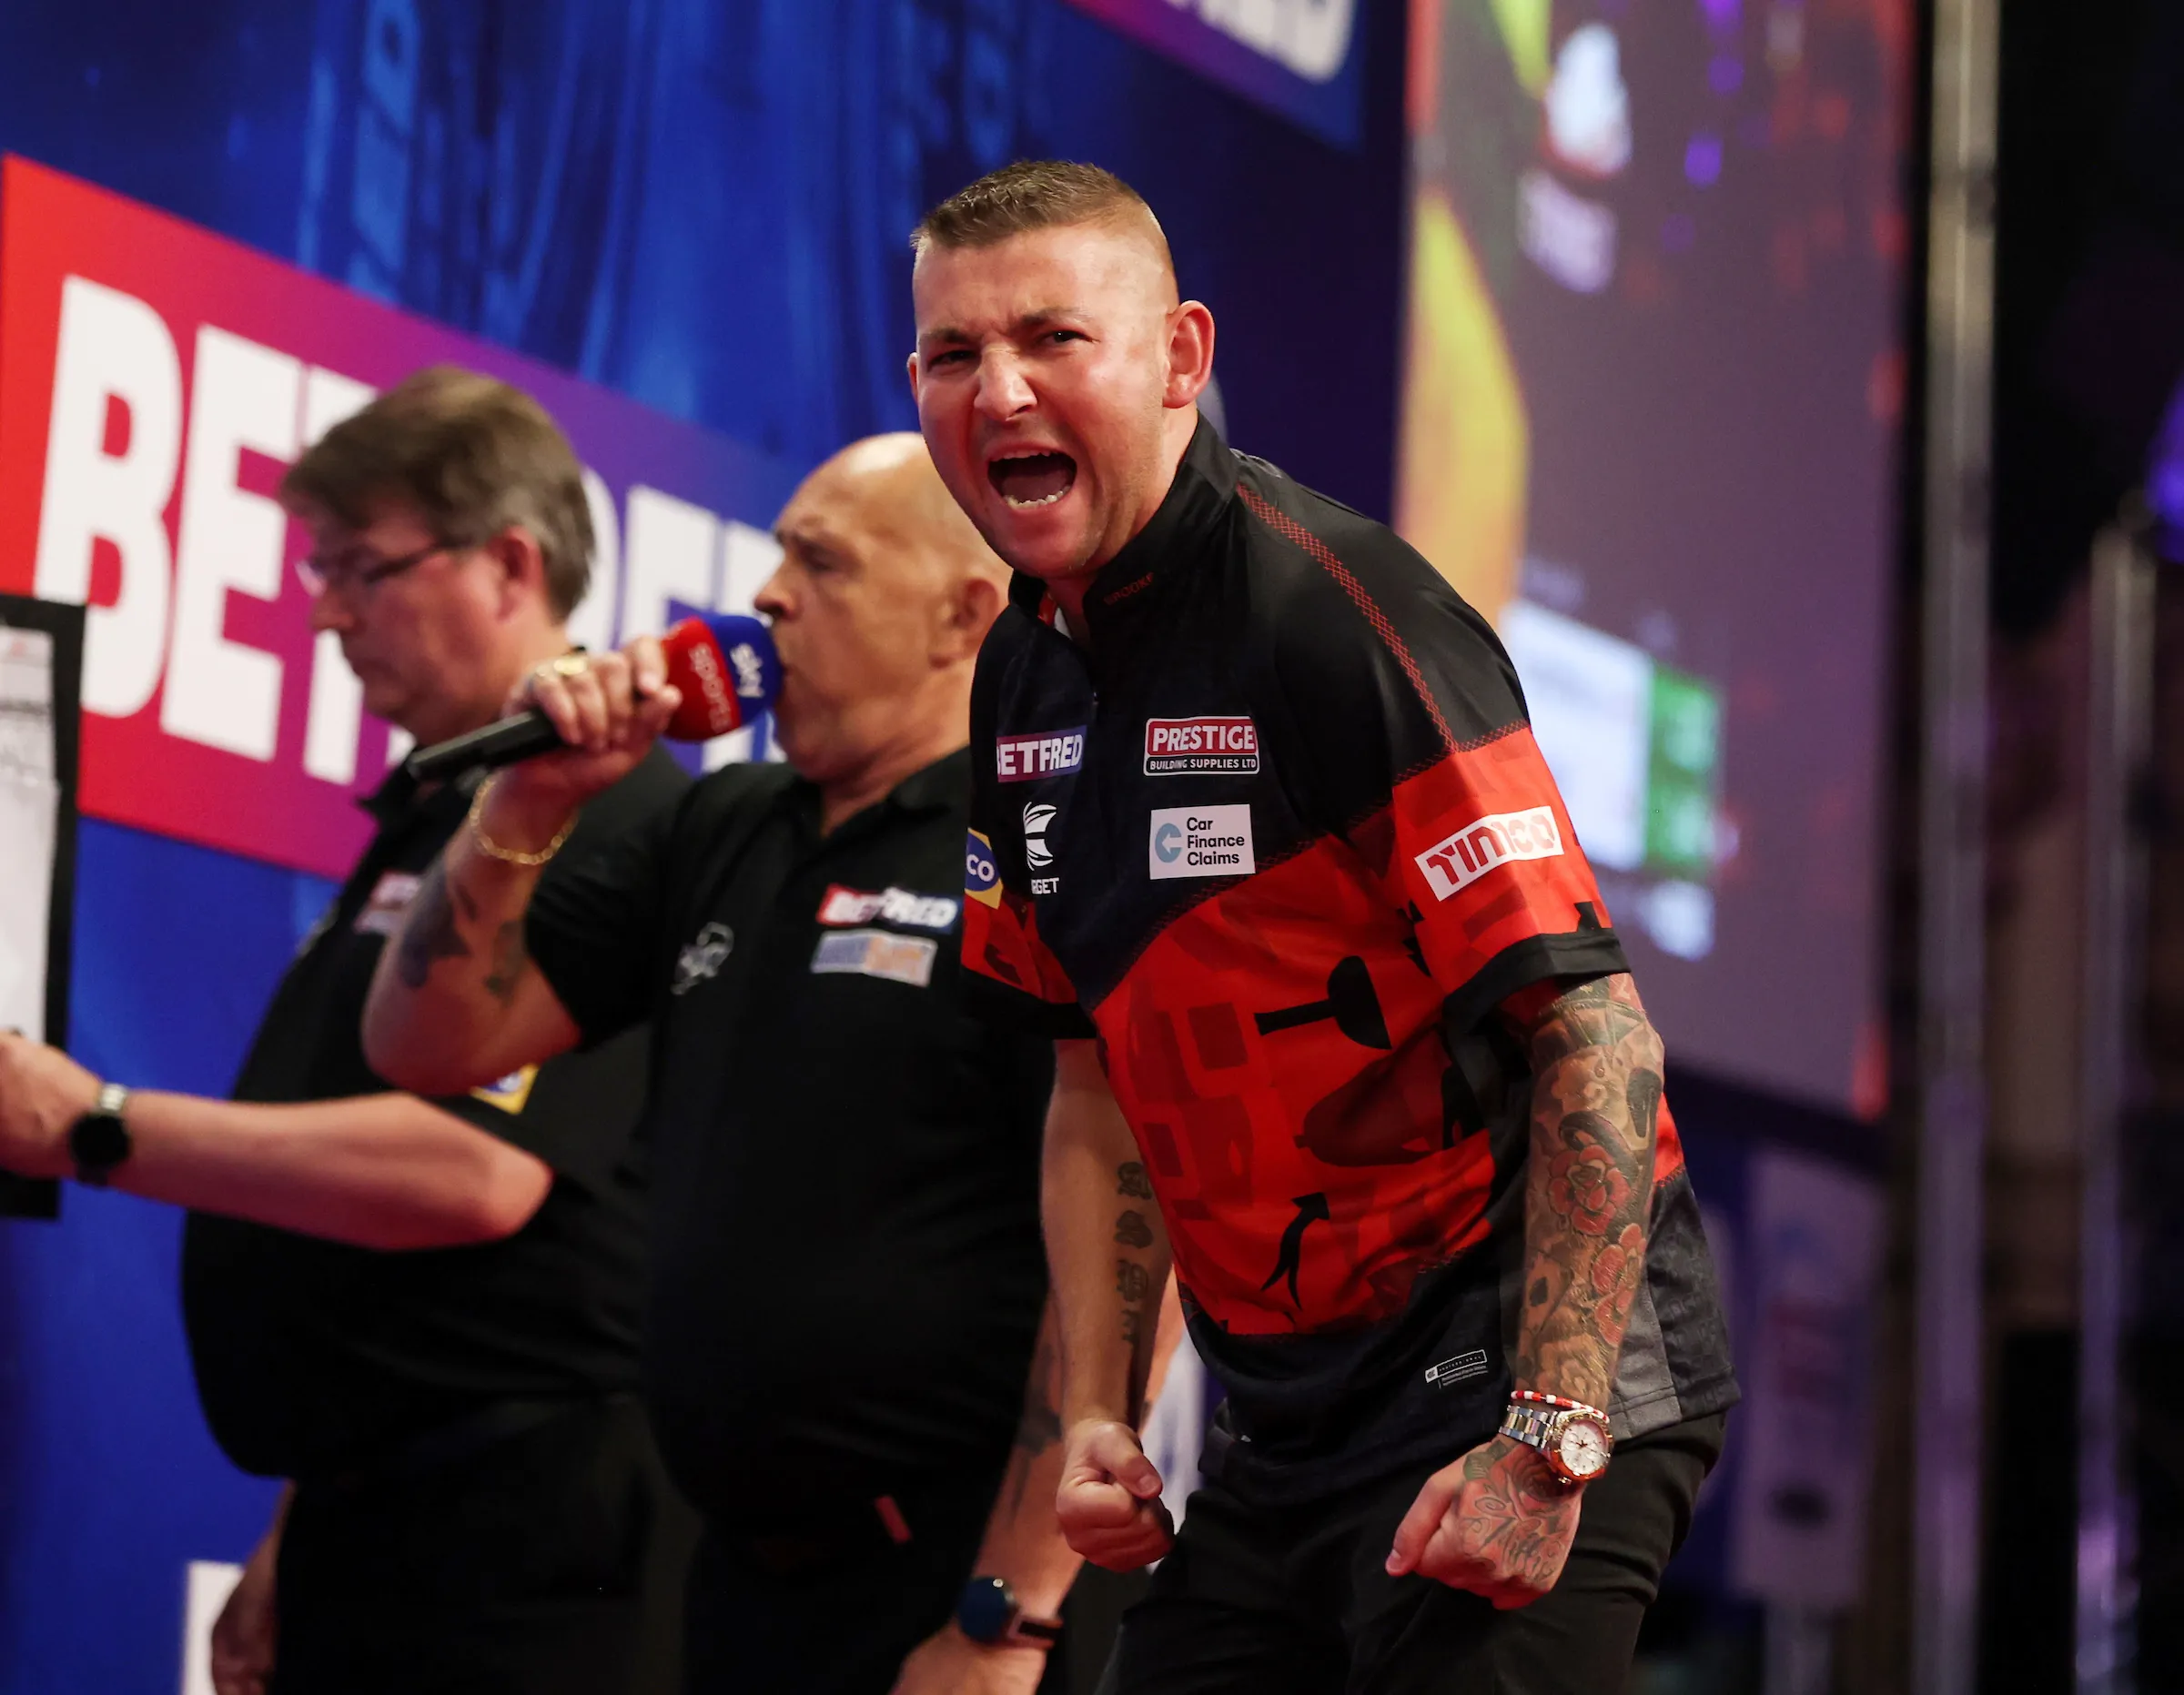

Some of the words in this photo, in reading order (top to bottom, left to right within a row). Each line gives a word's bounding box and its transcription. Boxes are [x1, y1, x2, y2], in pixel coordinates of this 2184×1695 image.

[1152, 724, 1256, 752] PRESTIGE
[996, 733, 1083, 775] ETFRED
[1149, 759, 1188, 771] BUILDING
[1189, 758, 1240, 769] SUPPLIES
[1241, 758, 1257, 769] LTD
[1186, 816, 1214, 832] Car
[1187, 834, 1246, 849] Finance
[1187, 851, 1240, 866] Claims
